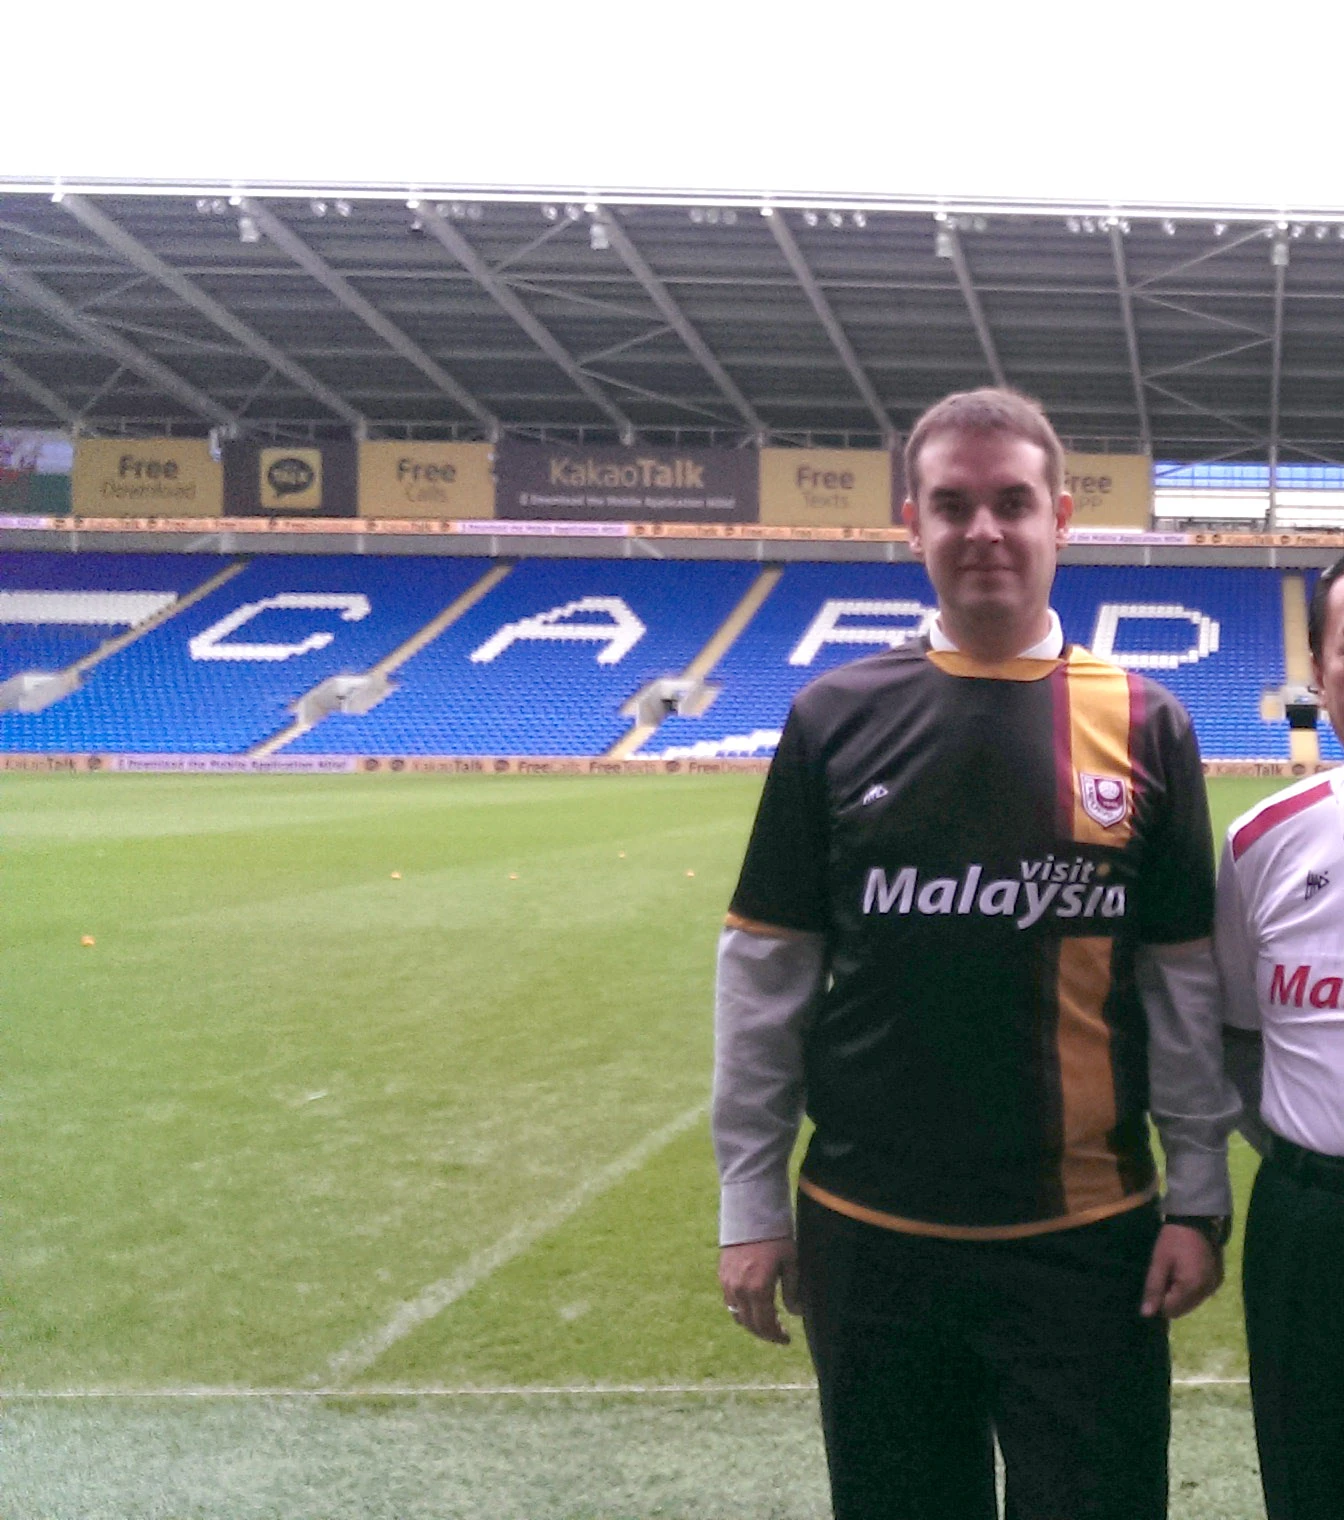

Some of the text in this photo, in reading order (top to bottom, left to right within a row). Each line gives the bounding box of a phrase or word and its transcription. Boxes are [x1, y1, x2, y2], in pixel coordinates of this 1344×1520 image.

[119, 455, 178, 479] Free
[397, 457, 456, 483] Free
[551, 457, 705, 488] KakaoTalk
[796, 465, 854, 490] Free
[1021, 855, 1094, 882] visit
[862, 864, 1126, 930] Malaysia
